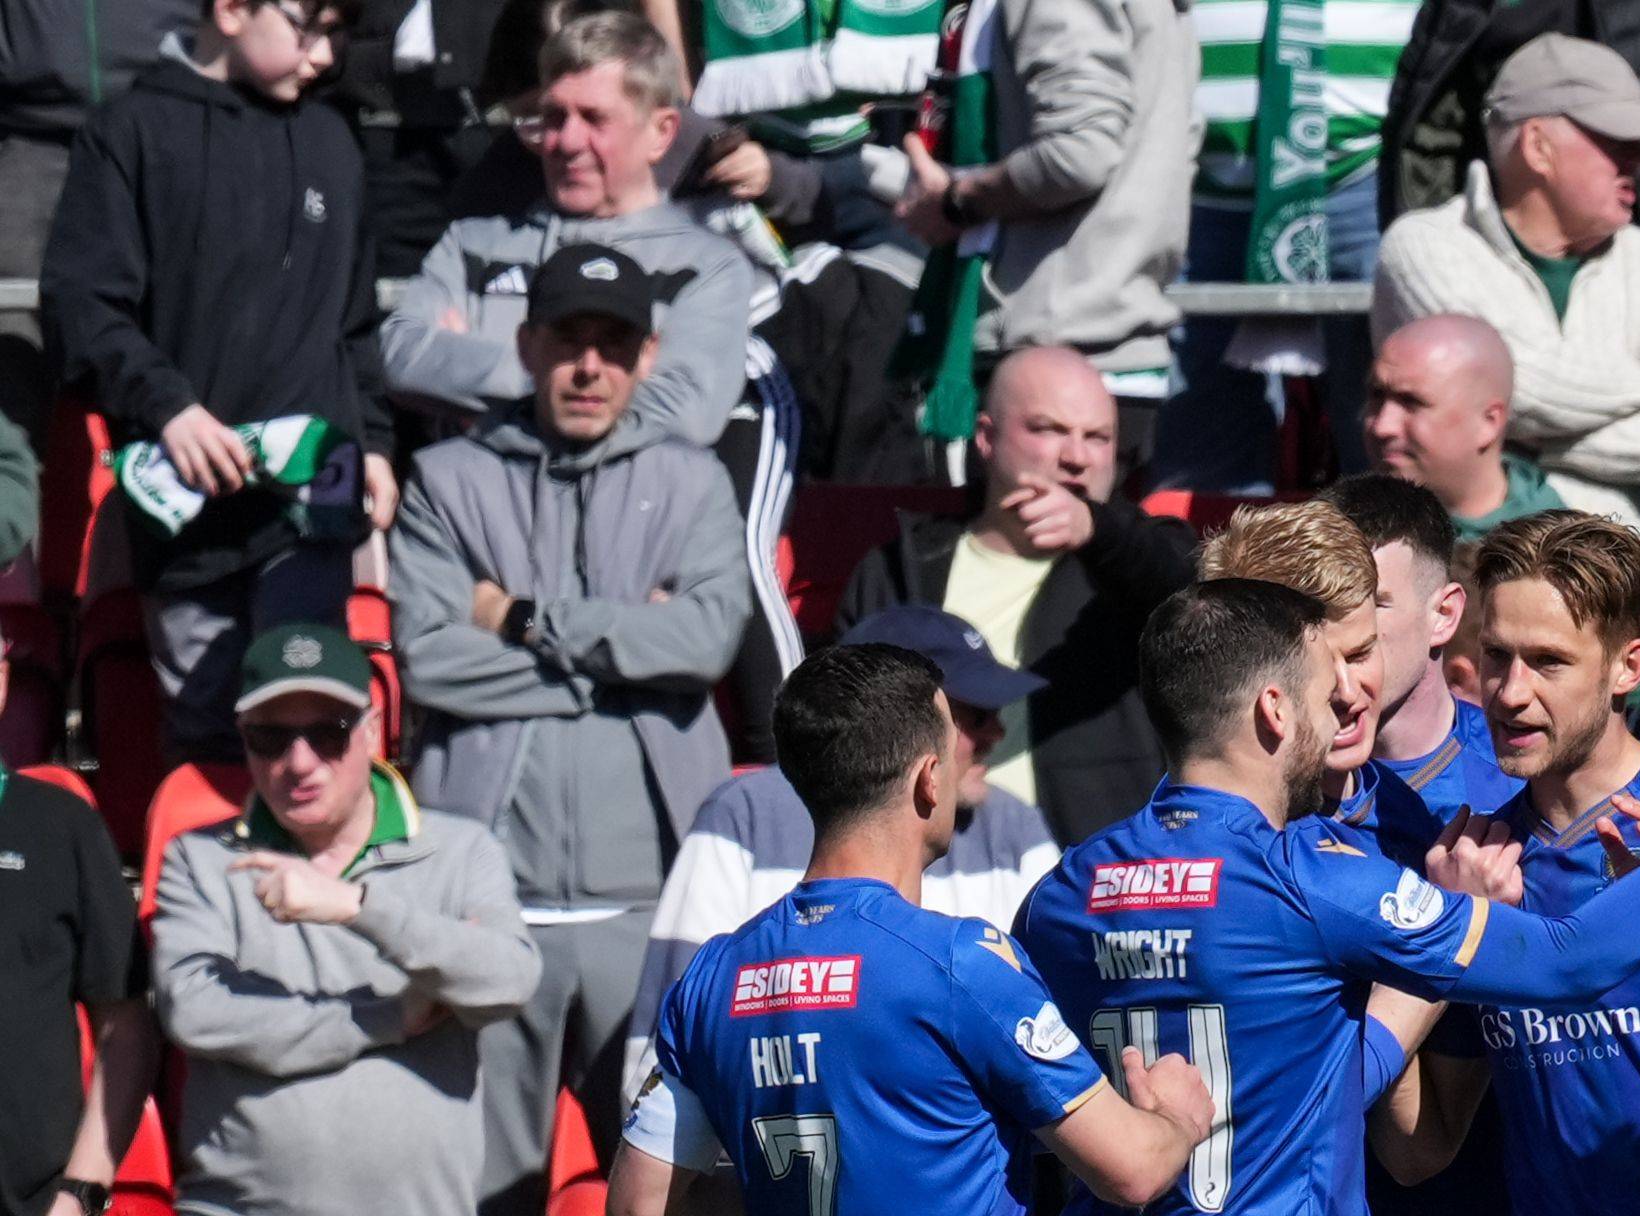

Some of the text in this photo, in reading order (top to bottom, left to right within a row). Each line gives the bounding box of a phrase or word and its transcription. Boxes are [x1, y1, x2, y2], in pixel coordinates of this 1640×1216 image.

[1105, 862, 1192, 897] SIDEY
[1092, 929, 1192, 981] WRIGHT
[751, 961, 832, 999] SIDEY
[1481, 1011, 1516, 1050] GS
[750, 1032, 821, 1088] HOLT
[1503, 1043, 1621, 1071] COSRUCTION
